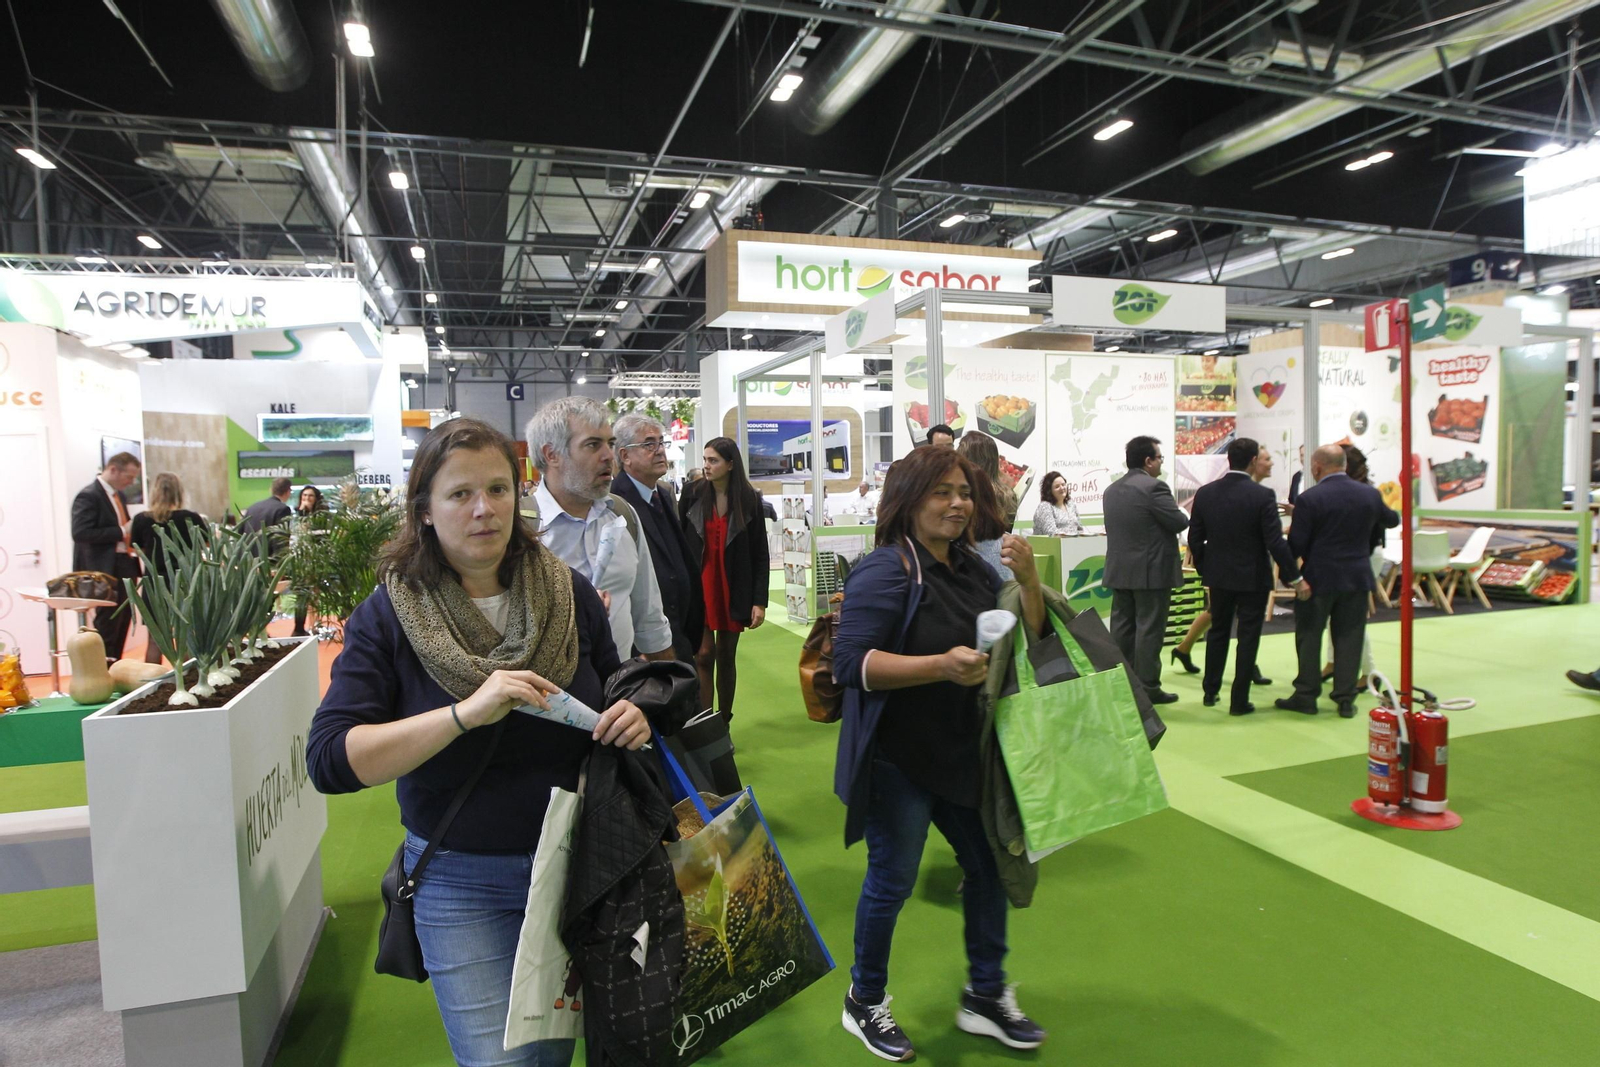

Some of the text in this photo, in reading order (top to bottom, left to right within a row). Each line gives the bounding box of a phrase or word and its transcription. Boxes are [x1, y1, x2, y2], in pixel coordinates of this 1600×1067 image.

[776, 254, 853, 292] hort
[1471, 258, 1486, 280] 9
[73, 290, 267, 319] AGRIDEMUR
[955, 366, 972, 382] The
[975, 366, 1009, 384] healthy
[1430, 357, 1489, 375] healthy
[1154, 371, 1168, 382] HAS
[1318, 367, 1367, 387] NATURAL
[1440, 372, 1479, 385] taste
[510, 385, 521, 399] C
[270, 403, 296, 413] KALE
[240, 466, 295, 477] escarolas
[1081, 478, 1098, 493] HAS
[246, 762, 283, 867] HUERTA
[704, 960, 796, 1024] Timac AGRO
